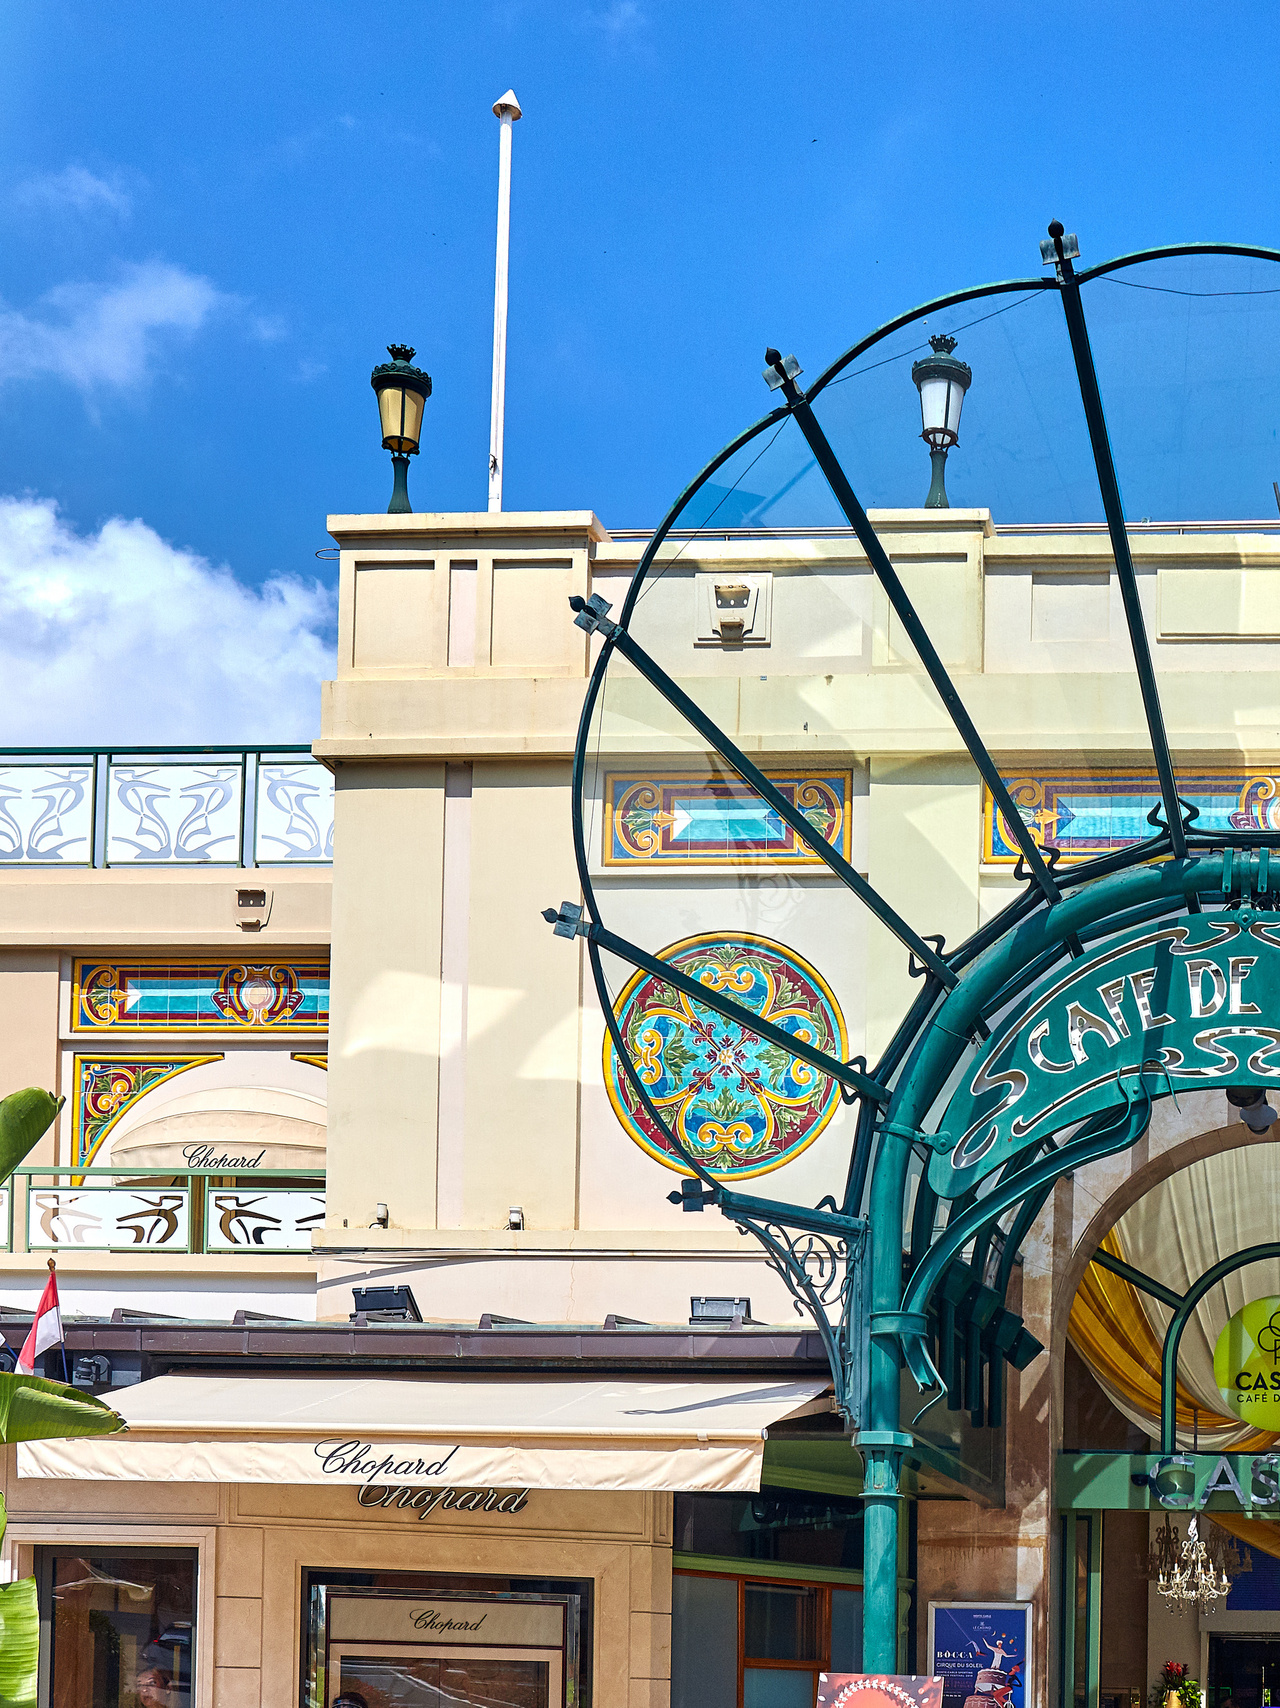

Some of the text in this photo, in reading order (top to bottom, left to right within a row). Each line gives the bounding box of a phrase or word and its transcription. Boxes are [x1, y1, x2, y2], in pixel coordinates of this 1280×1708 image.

[1184, 956, 1262, 1018] DE
[183, 1144, 266, 1168] Chopard
[1236, 1392, 1268, 1403] CAFÉ
[314, 1438, 461, 1483] Chopard
[409, 1608, 488, 1634] Chopard
